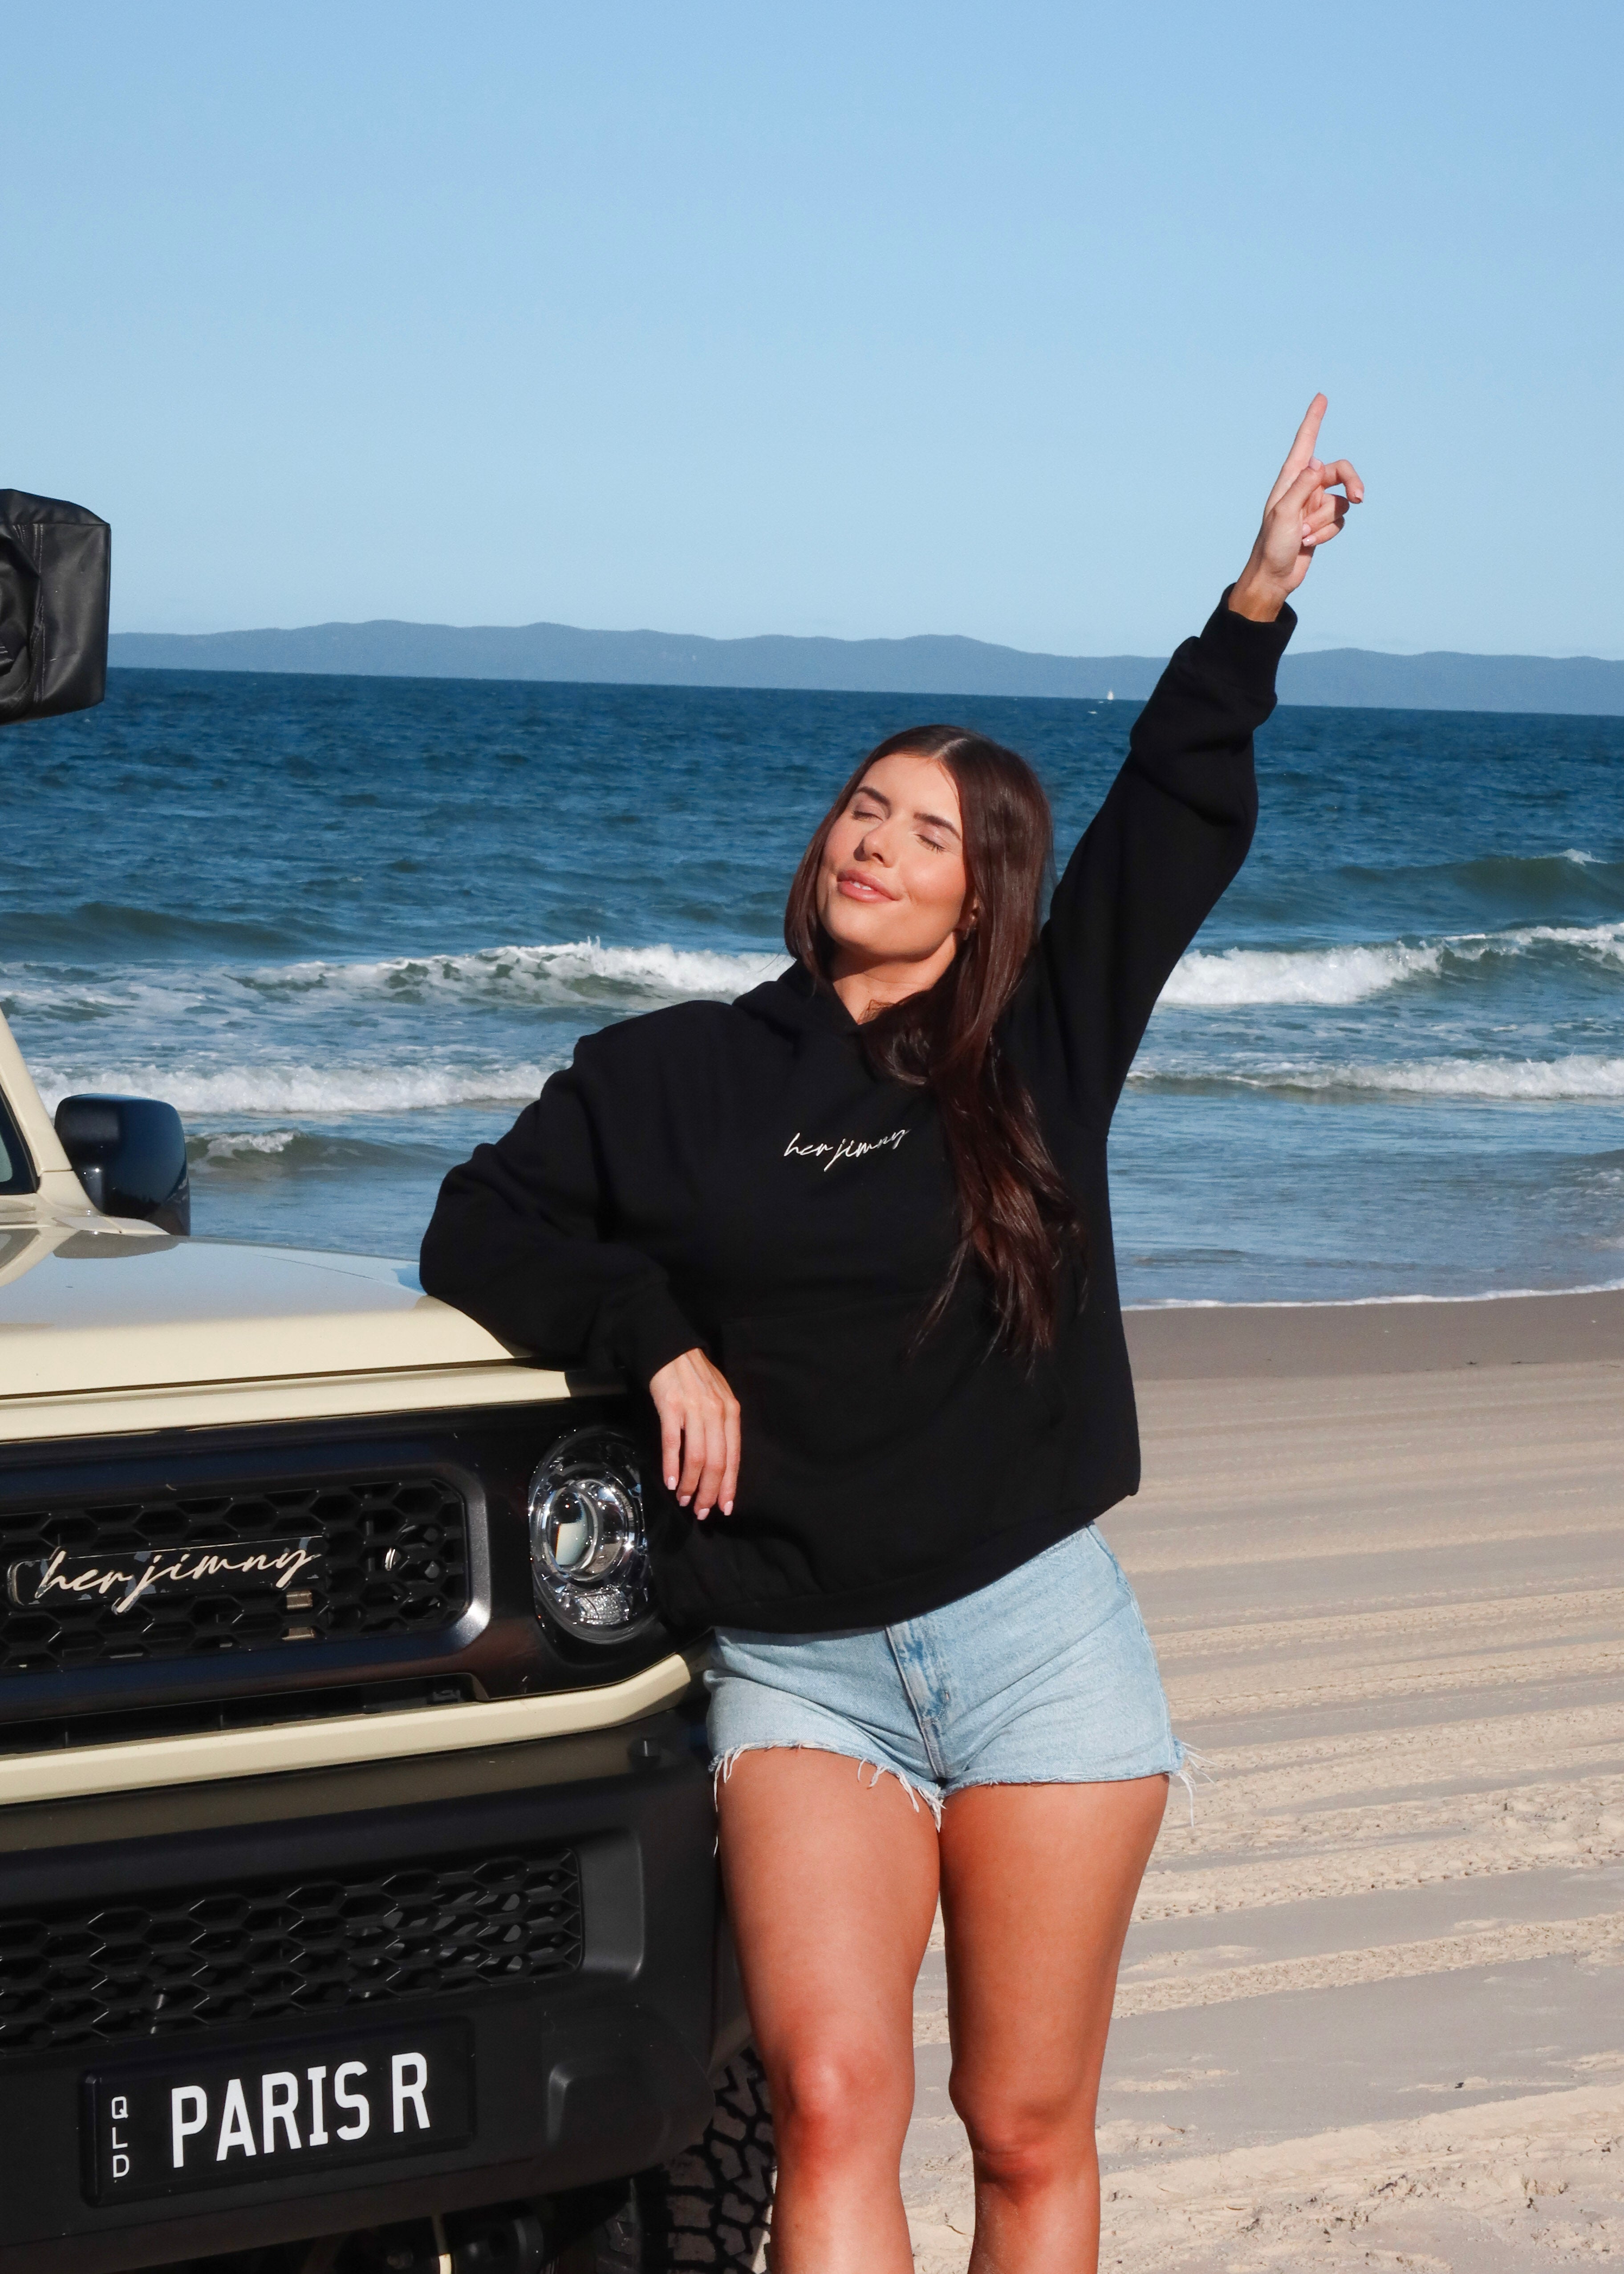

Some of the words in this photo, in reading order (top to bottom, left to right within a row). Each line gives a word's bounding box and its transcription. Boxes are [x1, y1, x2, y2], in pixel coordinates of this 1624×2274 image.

[111, 2096, 130, 2178] QLD
[171, 2061, 370, 2168] PARIS
[392, 2052, 430, 2133] R
